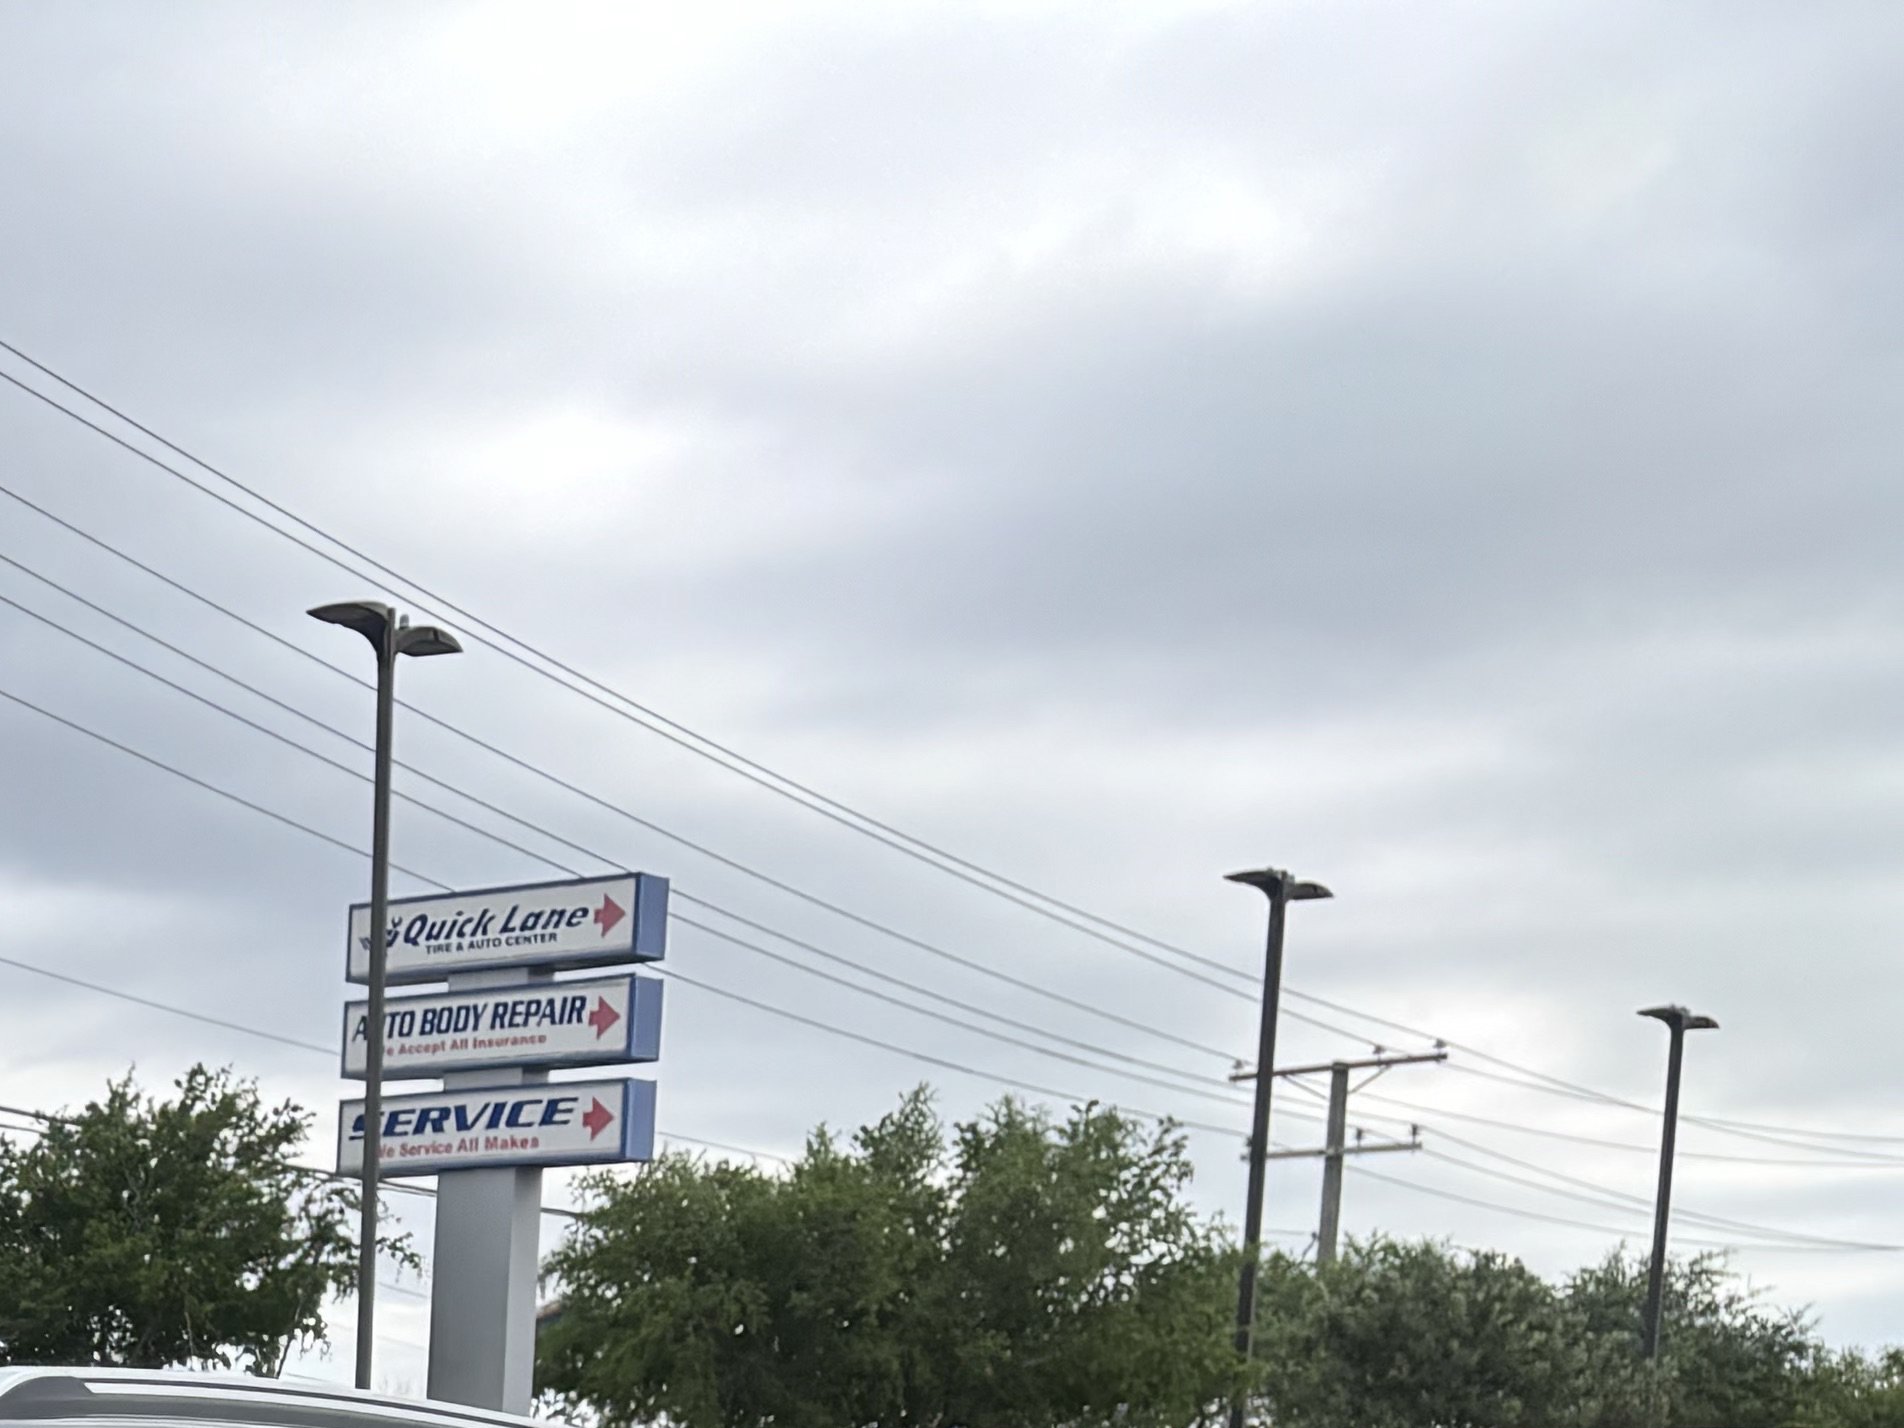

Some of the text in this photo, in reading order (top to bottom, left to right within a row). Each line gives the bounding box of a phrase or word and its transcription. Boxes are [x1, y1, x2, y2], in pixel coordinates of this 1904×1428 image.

[403, 904, 590, 947] Quick Lane
[426, 932, 558, 955] TIRE & AUTO CENTER
[352, 995, 587, 1042] ATO BODY REPAIR
[398, 1041, 446, 1057] Accept
[450, 1036, 469, 1051] All
[473, 1033, 547, 1050] Insurance
[400, 1140, 453, 1159] Service
[457, 1137, 479, 1153] All
[484, 1134, 540, 1151] Makes
